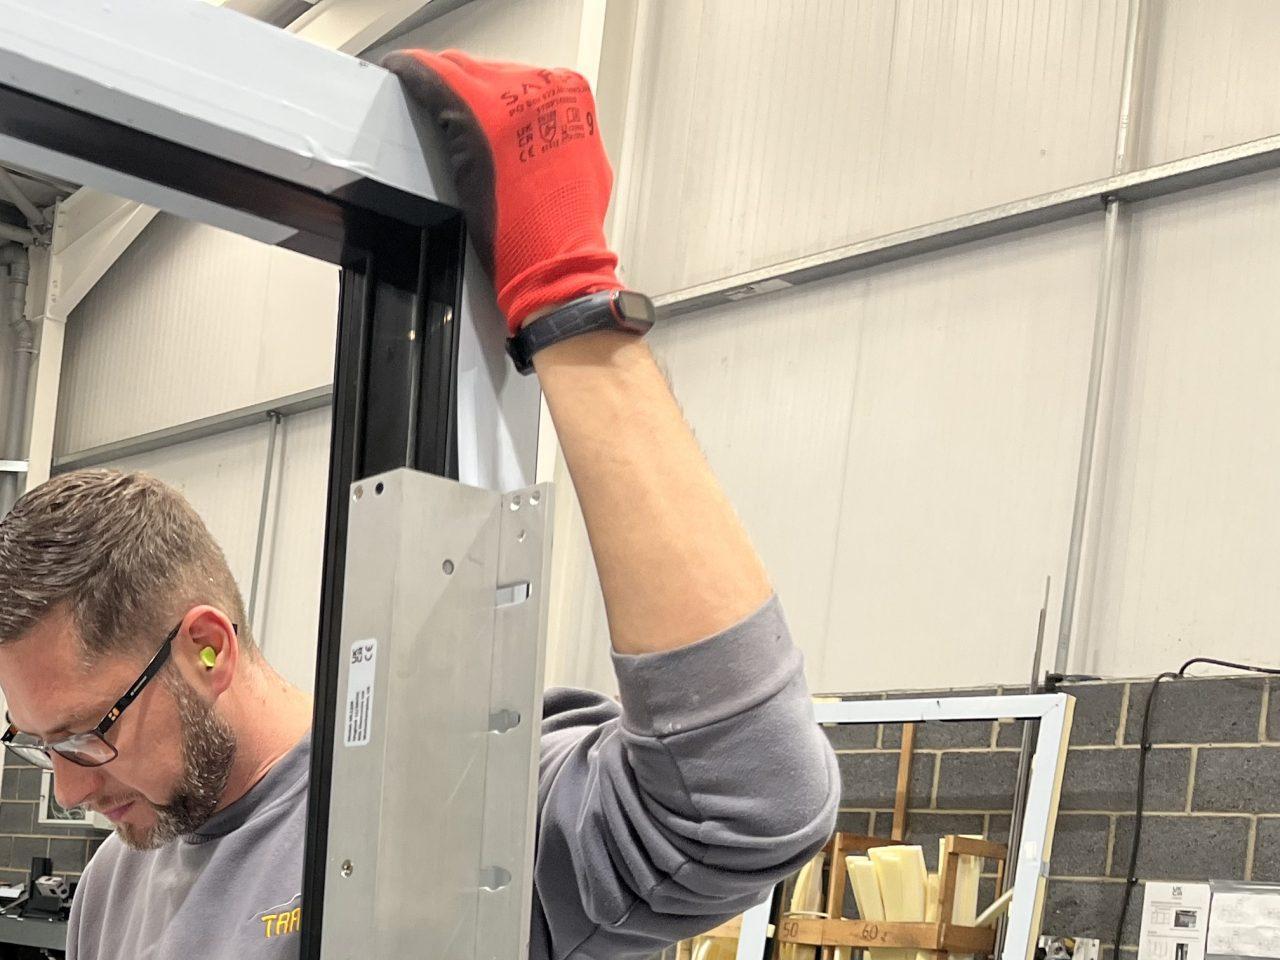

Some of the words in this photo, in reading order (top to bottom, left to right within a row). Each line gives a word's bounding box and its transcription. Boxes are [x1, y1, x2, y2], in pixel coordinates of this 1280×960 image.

[586, 111, 594, 136] 9
[783, 922, 799, 938] 50
[862, 923, 878, 941] 60
